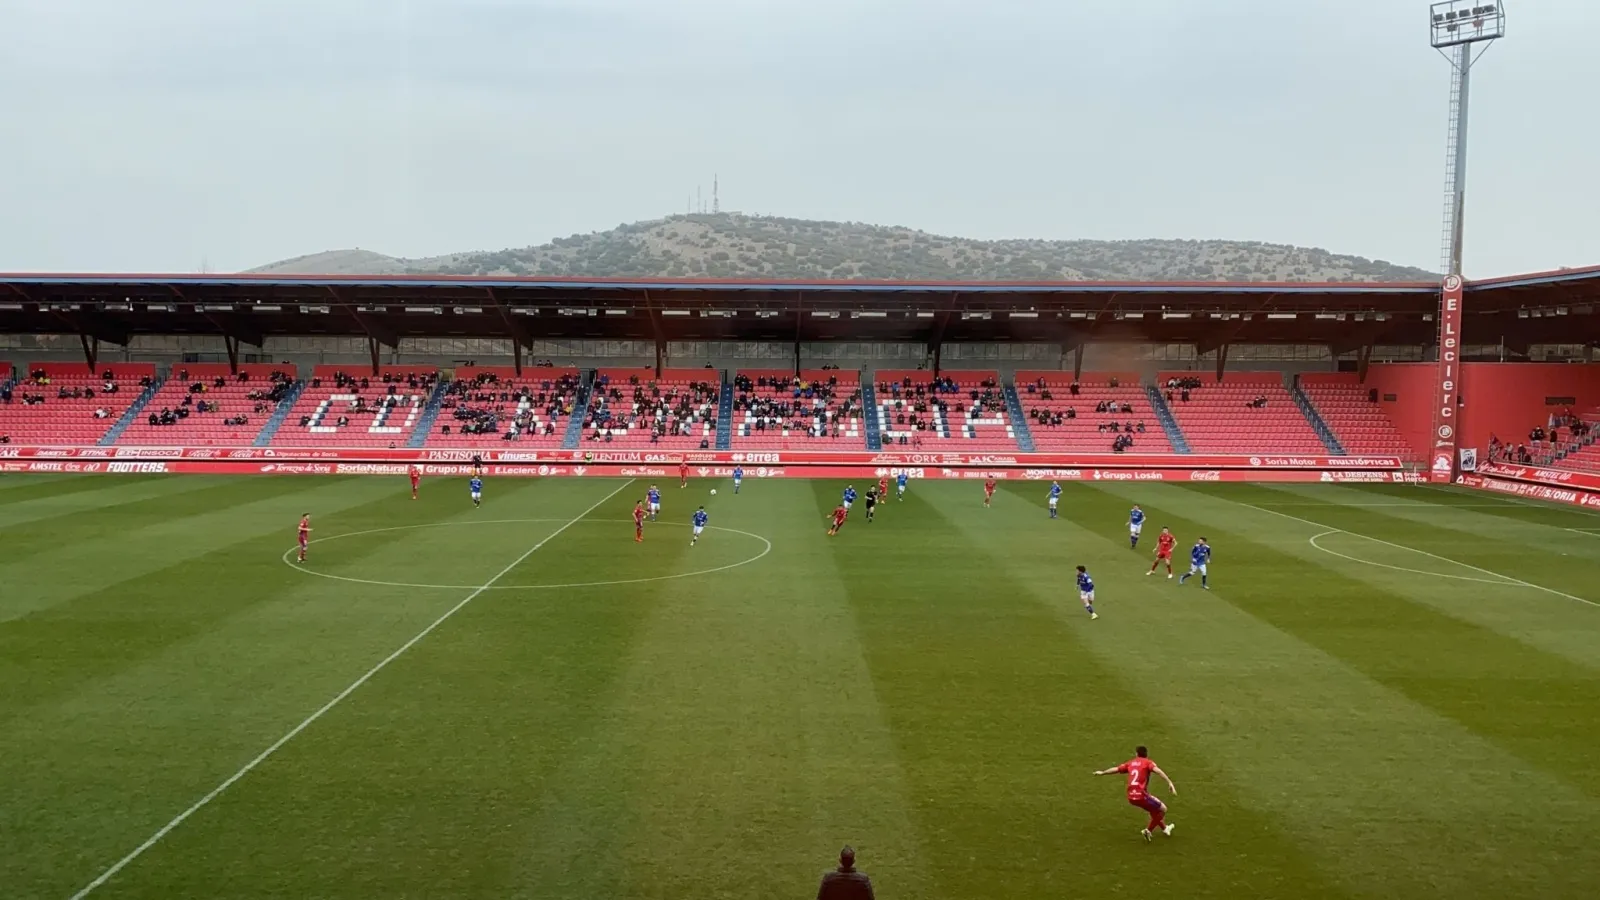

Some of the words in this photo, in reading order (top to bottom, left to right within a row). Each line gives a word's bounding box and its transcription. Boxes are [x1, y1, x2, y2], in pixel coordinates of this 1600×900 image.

[1441, 298, 1457, 418] E.Leclerc
[587, 452, 640, 460] ILENTIUM
[904, 454, 938, 463] YORK
[1289, 458, 1316, 466] Motor
[336, 464, 408, 472] SoriaNatural
[426, 466, 457, 474] Grupo
[1102, 470, 1133, 480] Grupo
[1134, 470, 1163, 480] Losán
[1130, 769, 1139, 786] 2
